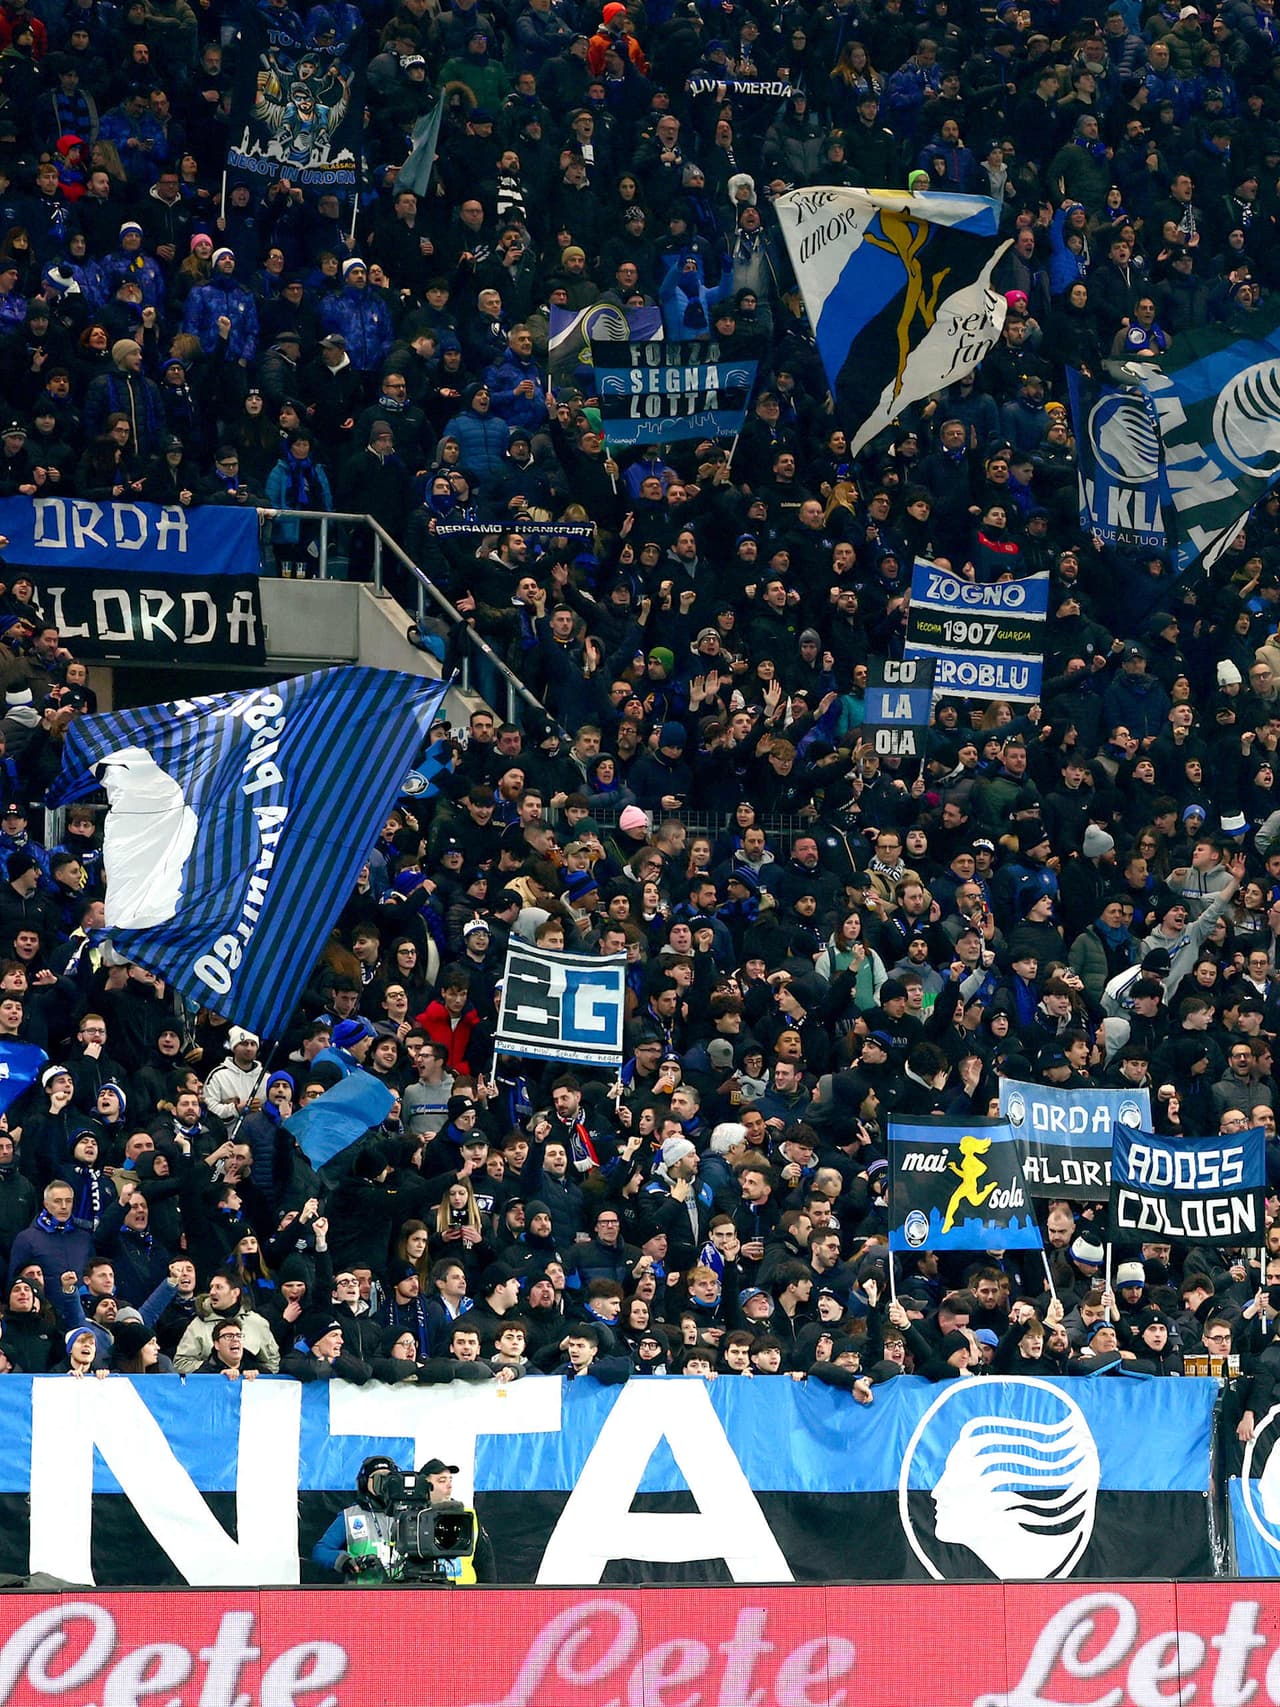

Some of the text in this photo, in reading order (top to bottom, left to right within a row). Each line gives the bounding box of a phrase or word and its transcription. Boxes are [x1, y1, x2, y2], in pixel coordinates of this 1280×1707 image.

[733, 81, 792, 98] MERDA
[800, 207, 858, 264] amore
[630, 365, 720, 394] SEGNA
[630, 390, 720, 419] LOTTA
[33, 498, 189, 552] ORDA
[436, 524, 502, 535] BERGAMO
[515, 525, 593, 537] FRANKFURT
[1132, 534, 1159, 546] TUO
[926, 574, 1026, 607] ZOGNO
[32, 586, 257, 646] LORDA
[943, 620, 999, 645] 1907
[997, 630, 1031, 641] GUARDIA
[934, 659, 1029, 690] EROBLU
[881, 694, 912, 719] LA
[502, 957, 620, 1045] BG
[1032, 1103, 1111, 1133] ORDA
[901, 1148, 949, 1173] mai
[1128, 1143, 1244, 1190] ADOSS
[988, 1176, 1025, 1209] sola
[1117, 1189, 1257, 1237] COLOGN
[0, 1602, 348, 1707] Lete
[470, 1598, 857, 1707] Lete
[972, 1592, 1280, 1707] Let
